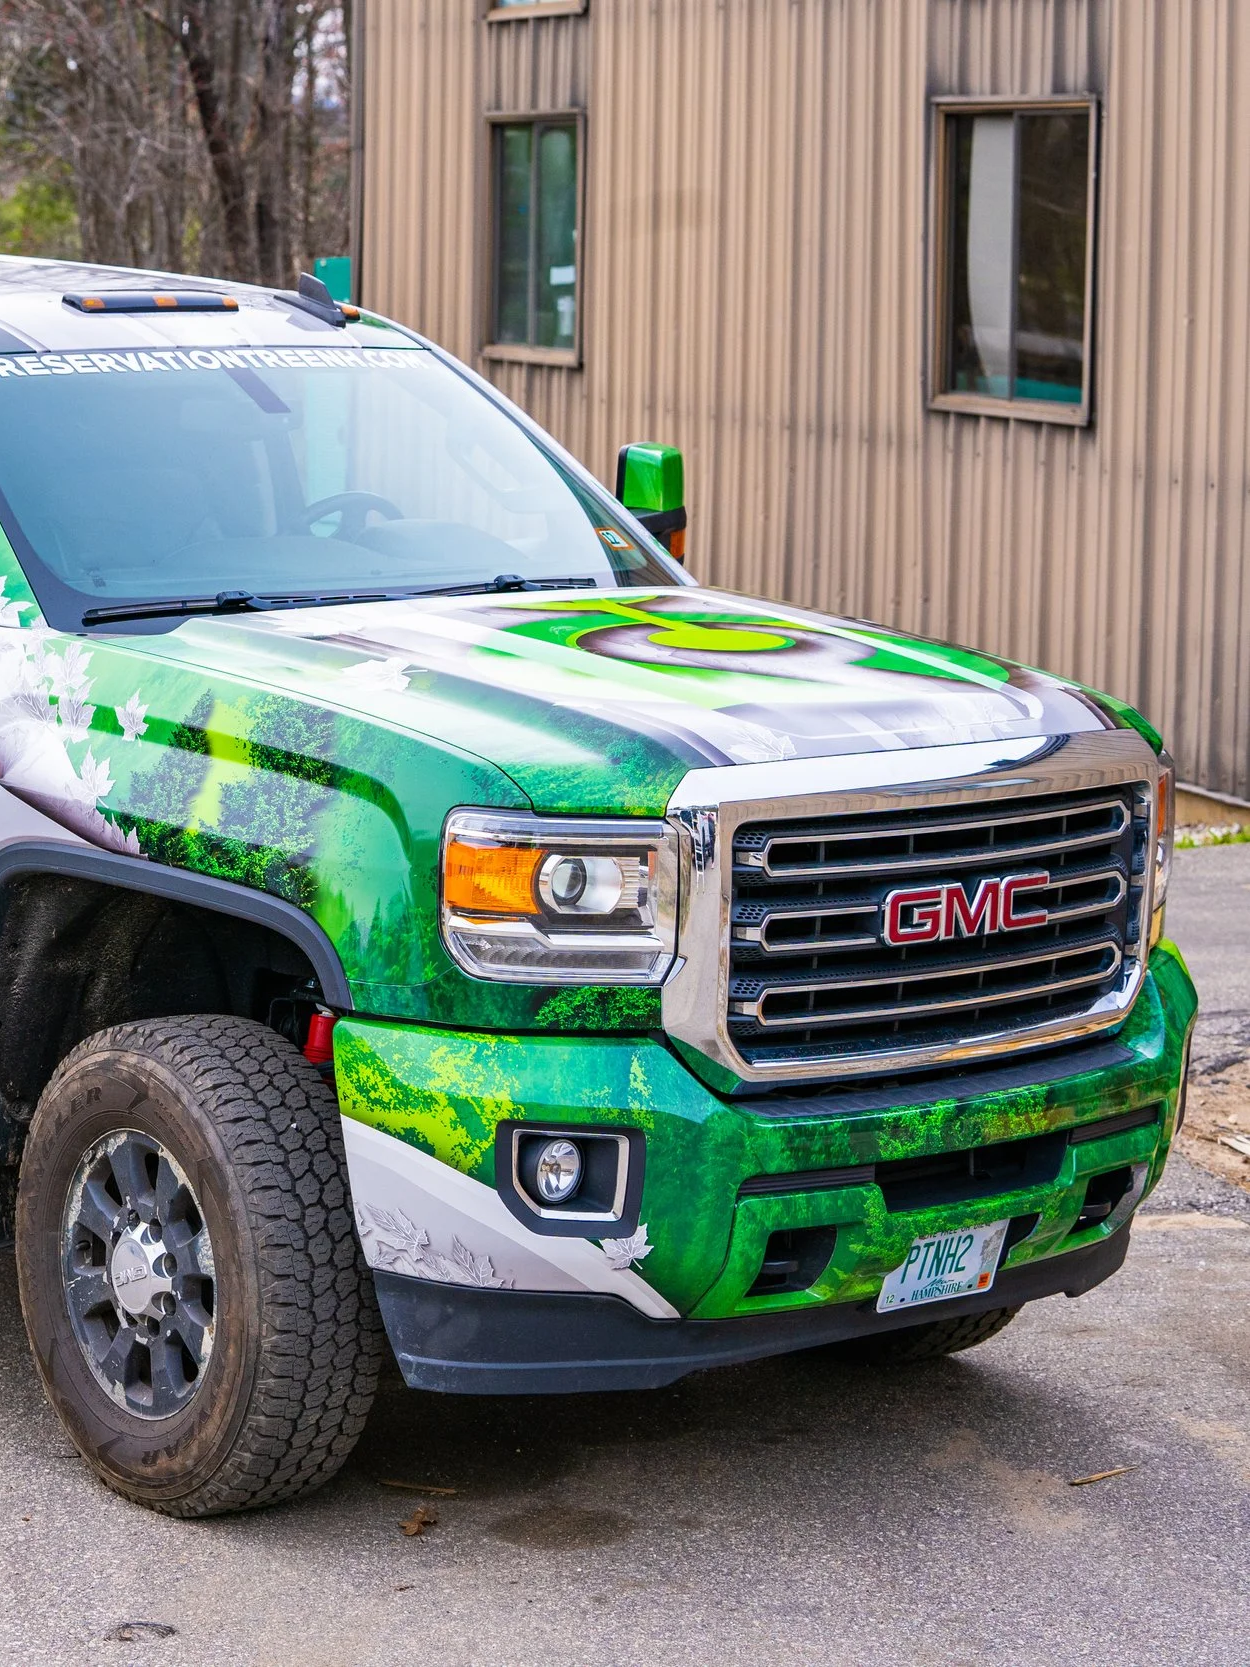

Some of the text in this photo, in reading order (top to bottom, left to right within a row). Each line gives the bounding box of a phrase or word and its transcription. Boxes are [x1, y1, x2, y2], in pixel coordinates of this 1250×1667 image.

[882, 871, 1050, 947] GMC
[900, 1233, 975, 1285] PTNH2
[911, 1281, 963, 1302] HAMPSHIRE
